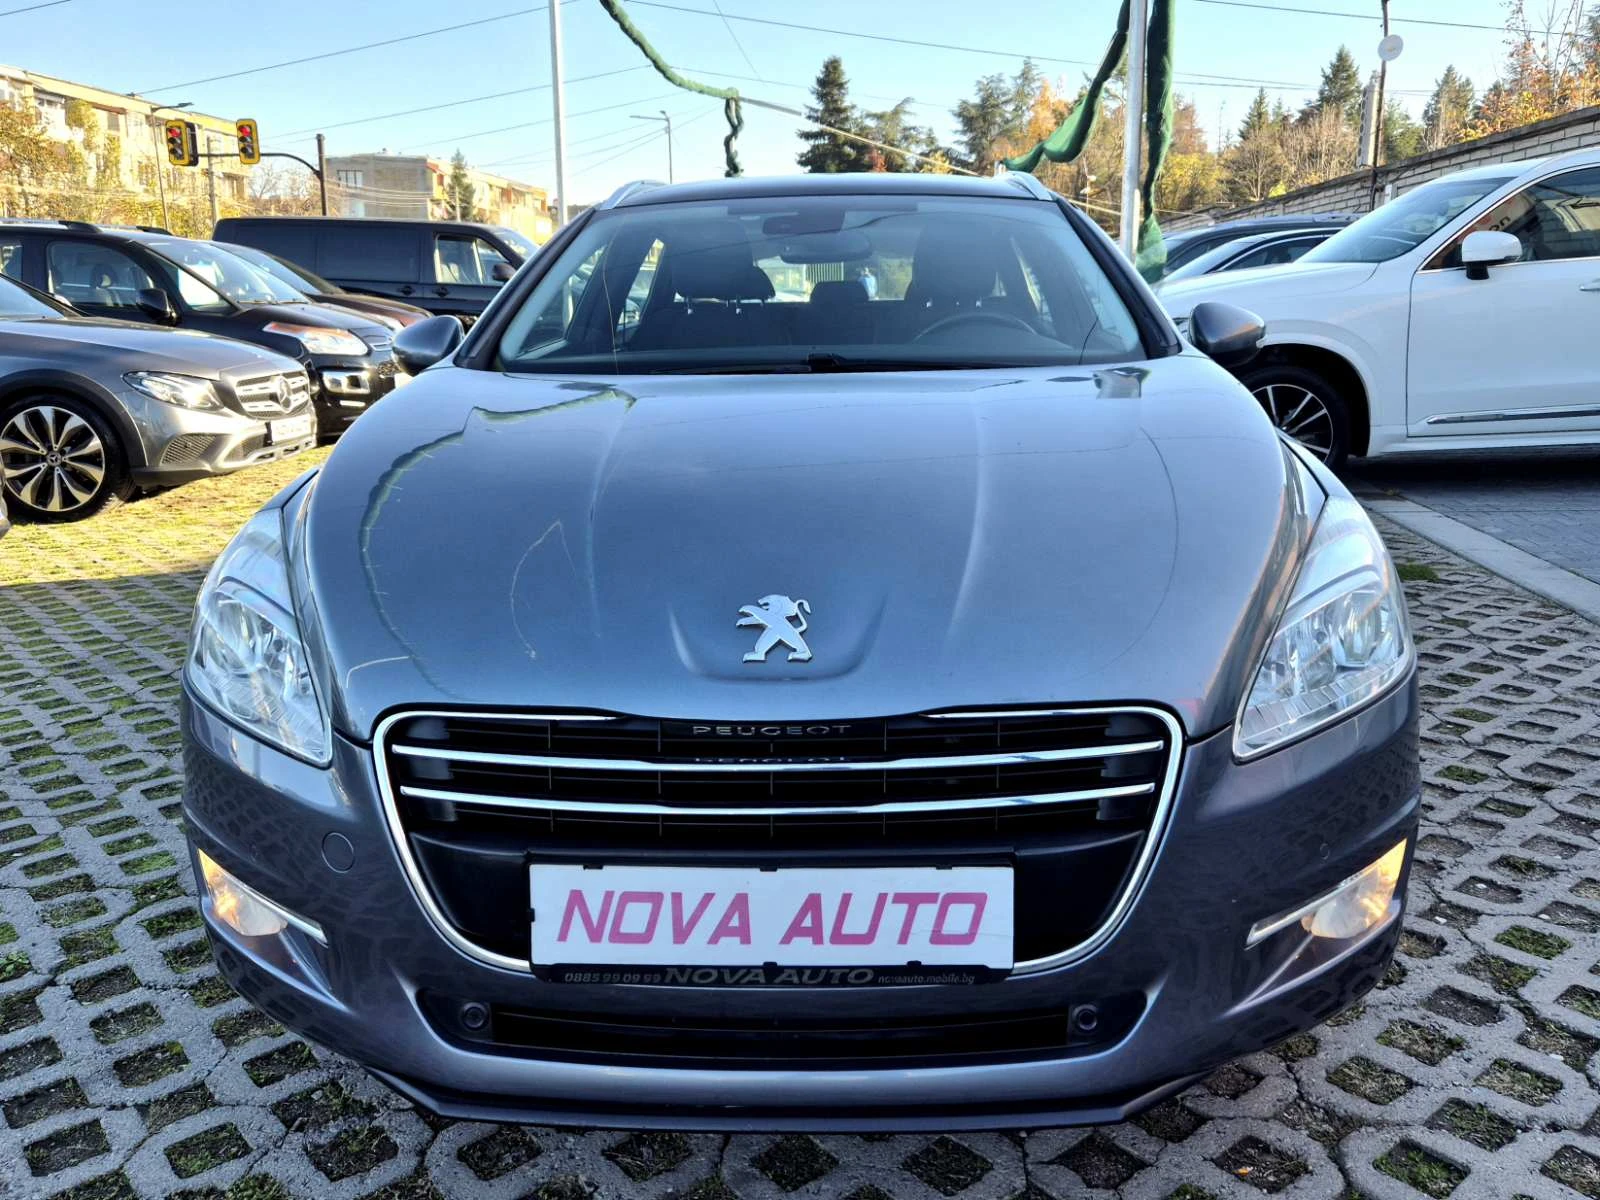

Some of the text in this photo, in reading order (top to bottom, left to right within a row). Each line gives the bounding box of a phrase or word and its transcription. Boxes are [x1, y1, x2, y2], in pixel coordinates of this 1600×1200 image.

[692, 725, 851, 736] PEUGEOT
[556, 889, 988, 945] NOVA AUTO
[564, 973, 600, 983] 0885
[623, 973, 640, 983] 09
[664, 968, 766, 984] NOVA
[773, 968, 875, 984] AUTO
